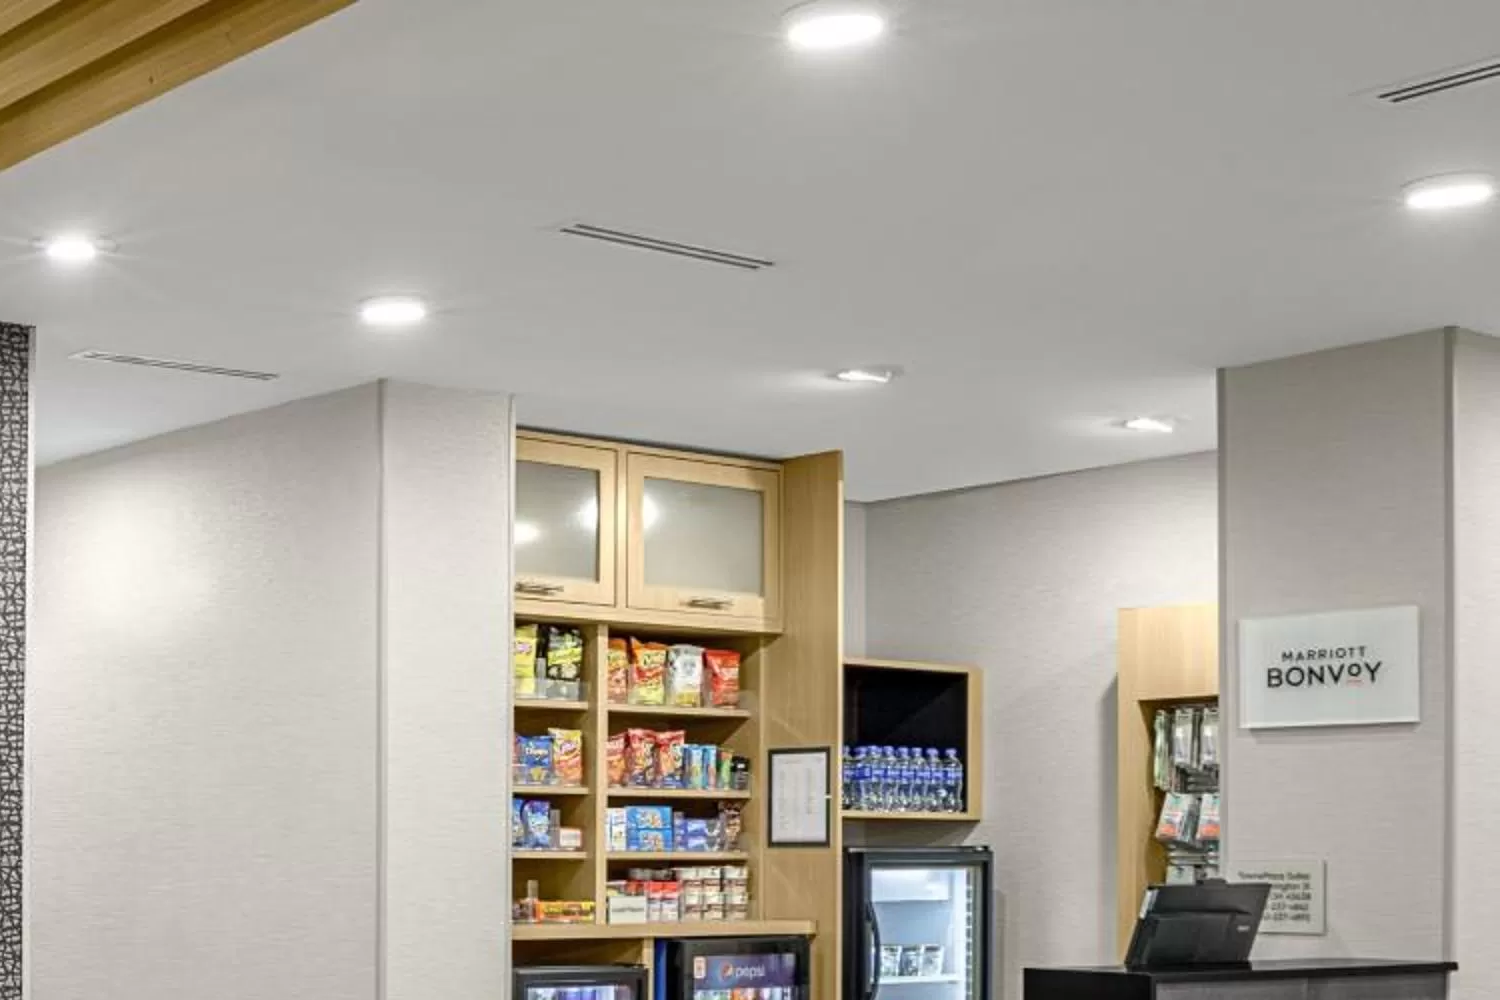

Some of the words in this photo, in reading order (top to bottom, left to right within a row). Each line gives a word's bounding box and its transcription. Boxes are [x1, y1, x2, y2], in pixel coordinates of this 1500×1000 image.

[1281, 645, 1366, 661] MARRIOTT
[1266, 661, 1382, 688] BONVOY
[735, 963, 766, 980] pepsi
